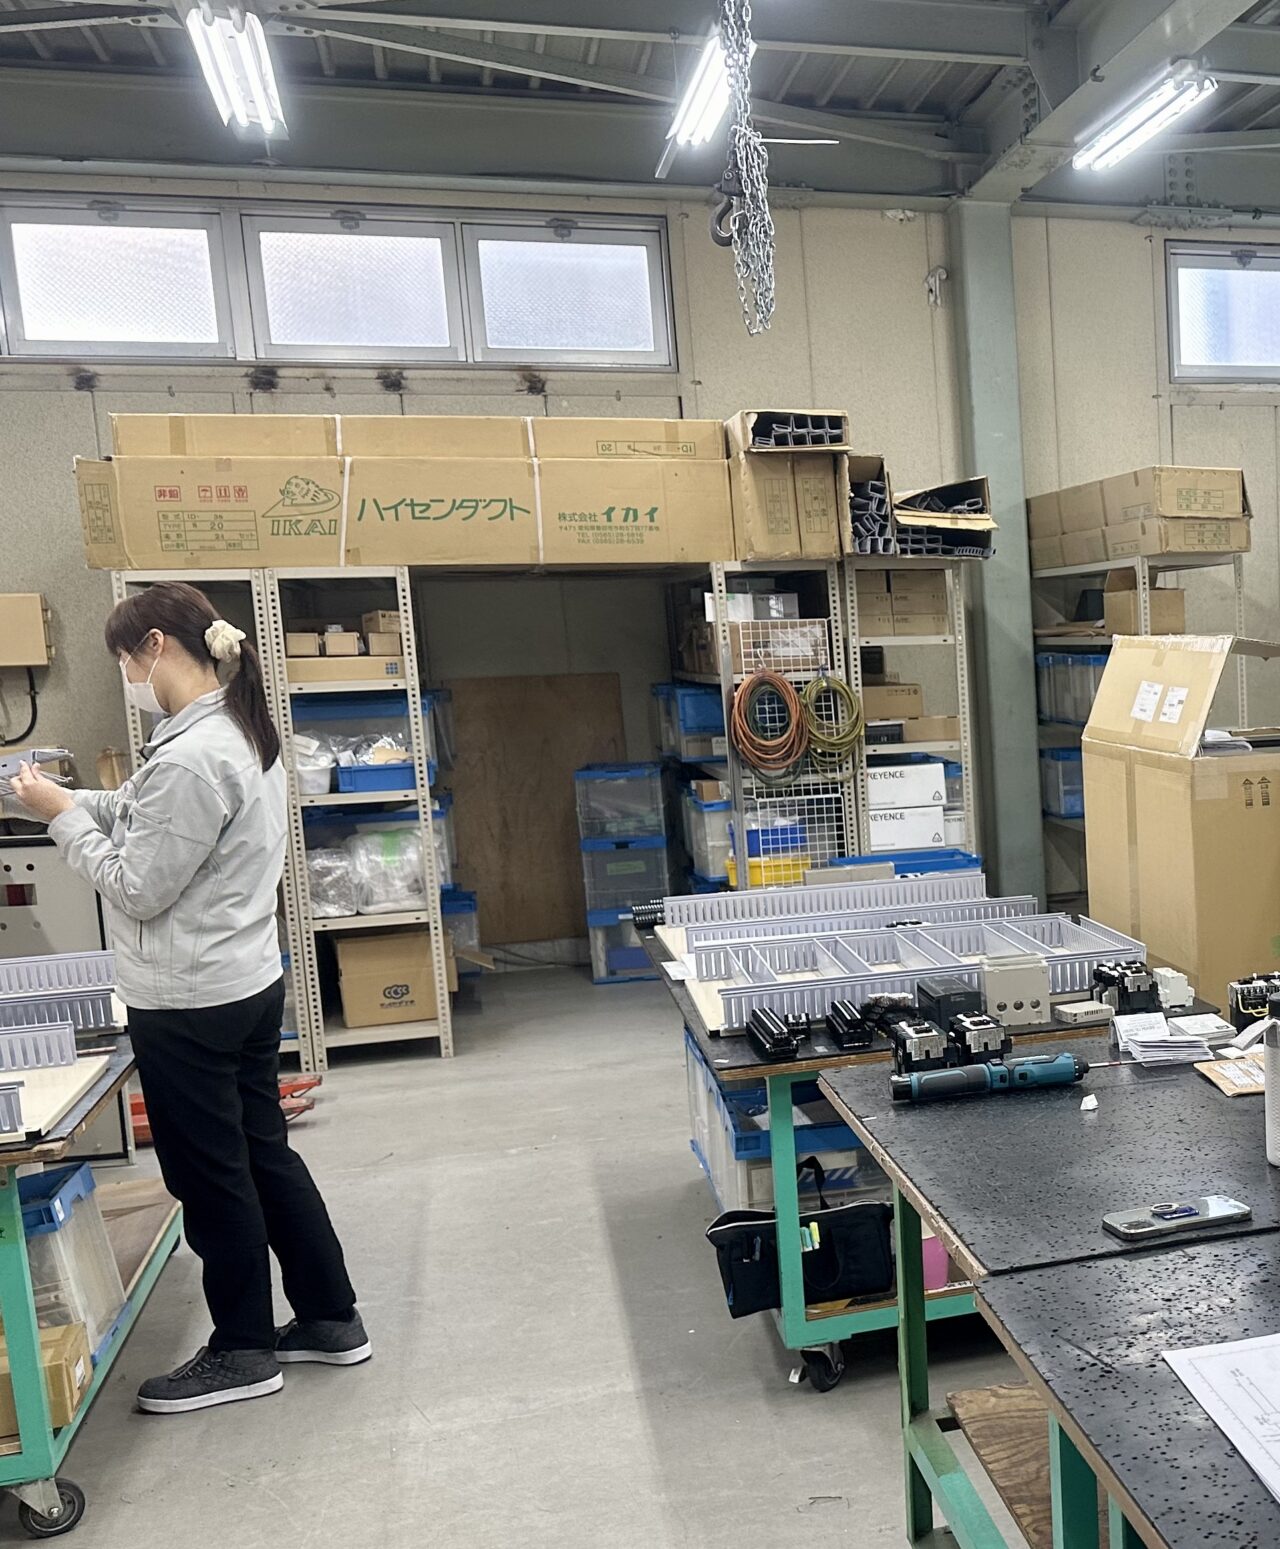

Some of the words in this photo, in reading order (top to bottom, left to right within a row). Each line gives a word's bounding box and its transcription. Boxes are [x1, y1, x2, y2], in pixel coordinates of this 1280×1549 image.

[357, 498, 532, 522] ハイセンダクト
[558, 511, 599, 523] 株式会社
[601, 506, 659, 523] イカイ
[209, 521, 224, 531] 20
[271, 519, 338, 536] IKAI
